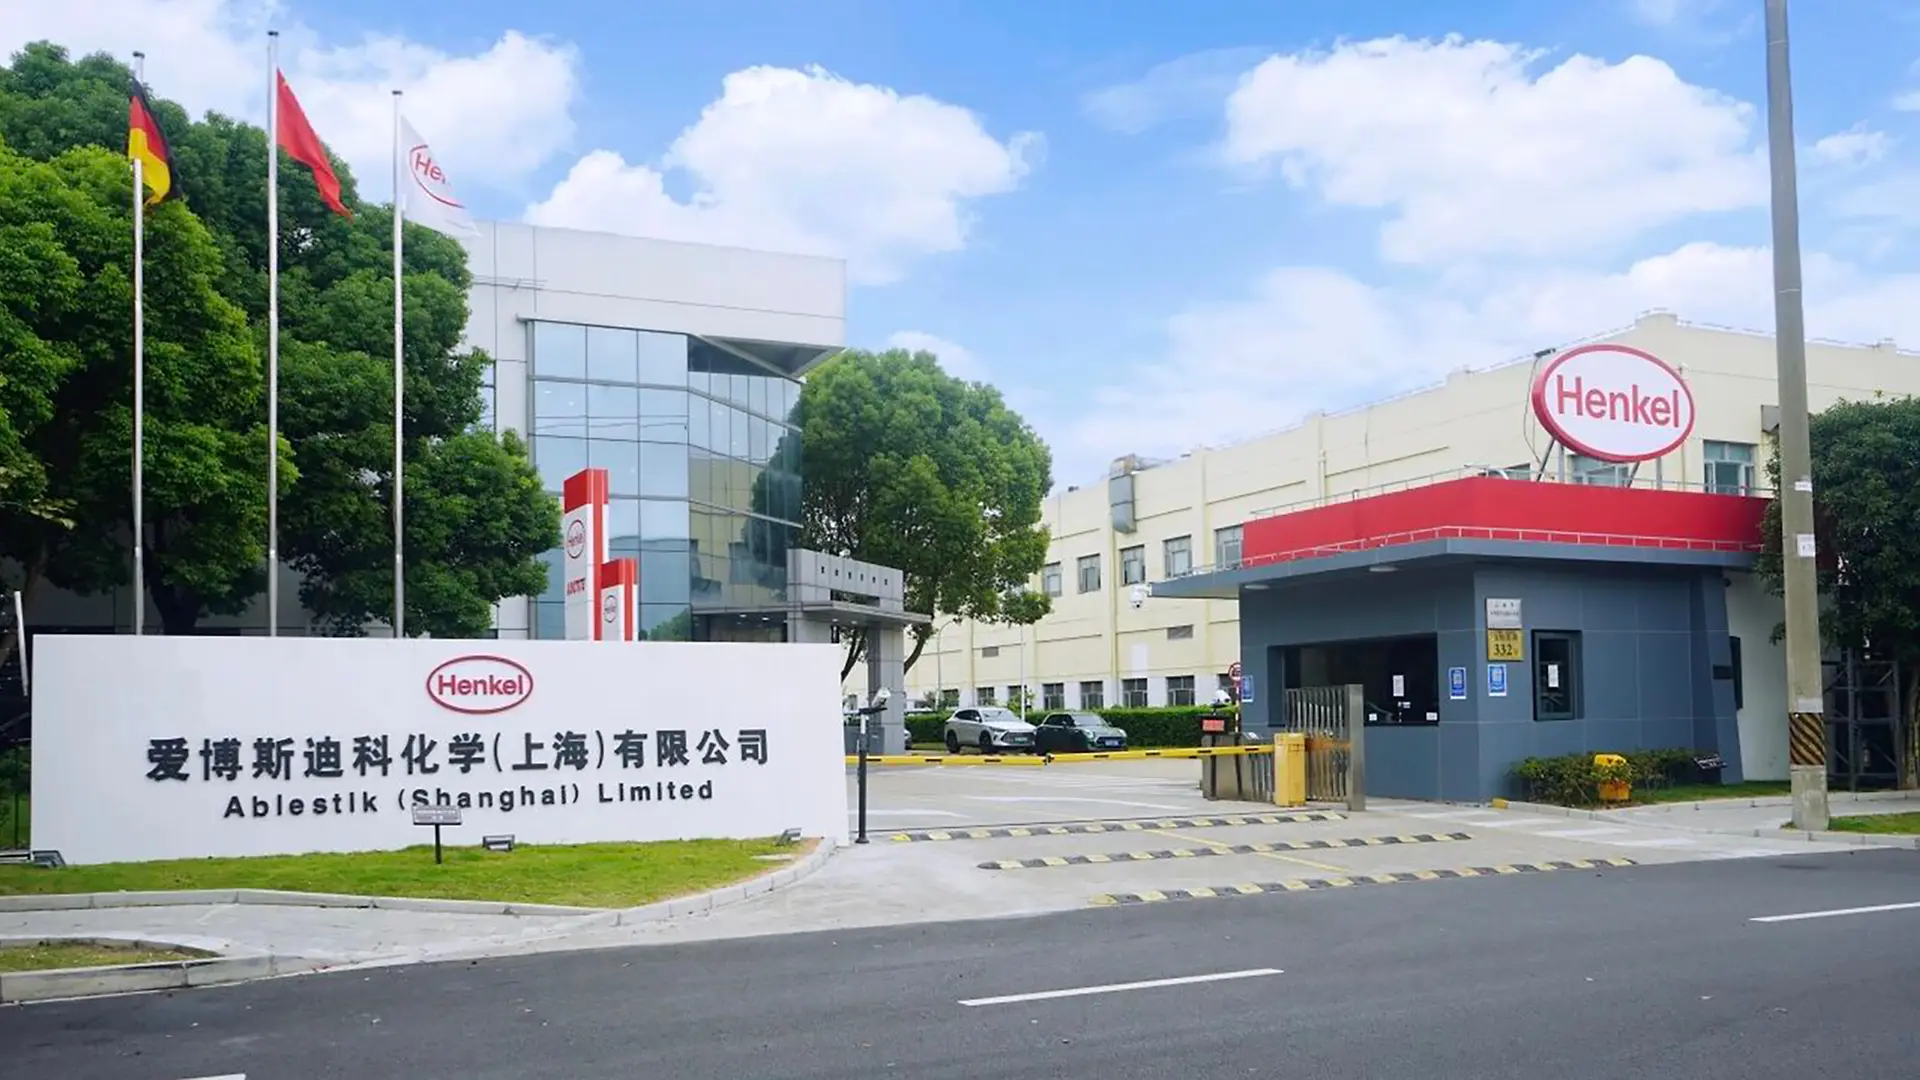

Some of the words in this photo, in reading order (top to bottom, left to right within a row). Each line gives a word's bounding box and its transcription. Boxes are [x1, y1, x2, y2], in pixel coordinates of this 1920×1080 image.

[1557, 374, 1680, 428] Henkel
[438, 674, 523, 696] Henkel
[223, 791, 378, 819] Ablestik
[398, 783, 579, 813] (Shanghai)
[598, 780, 713, 803] Limited
